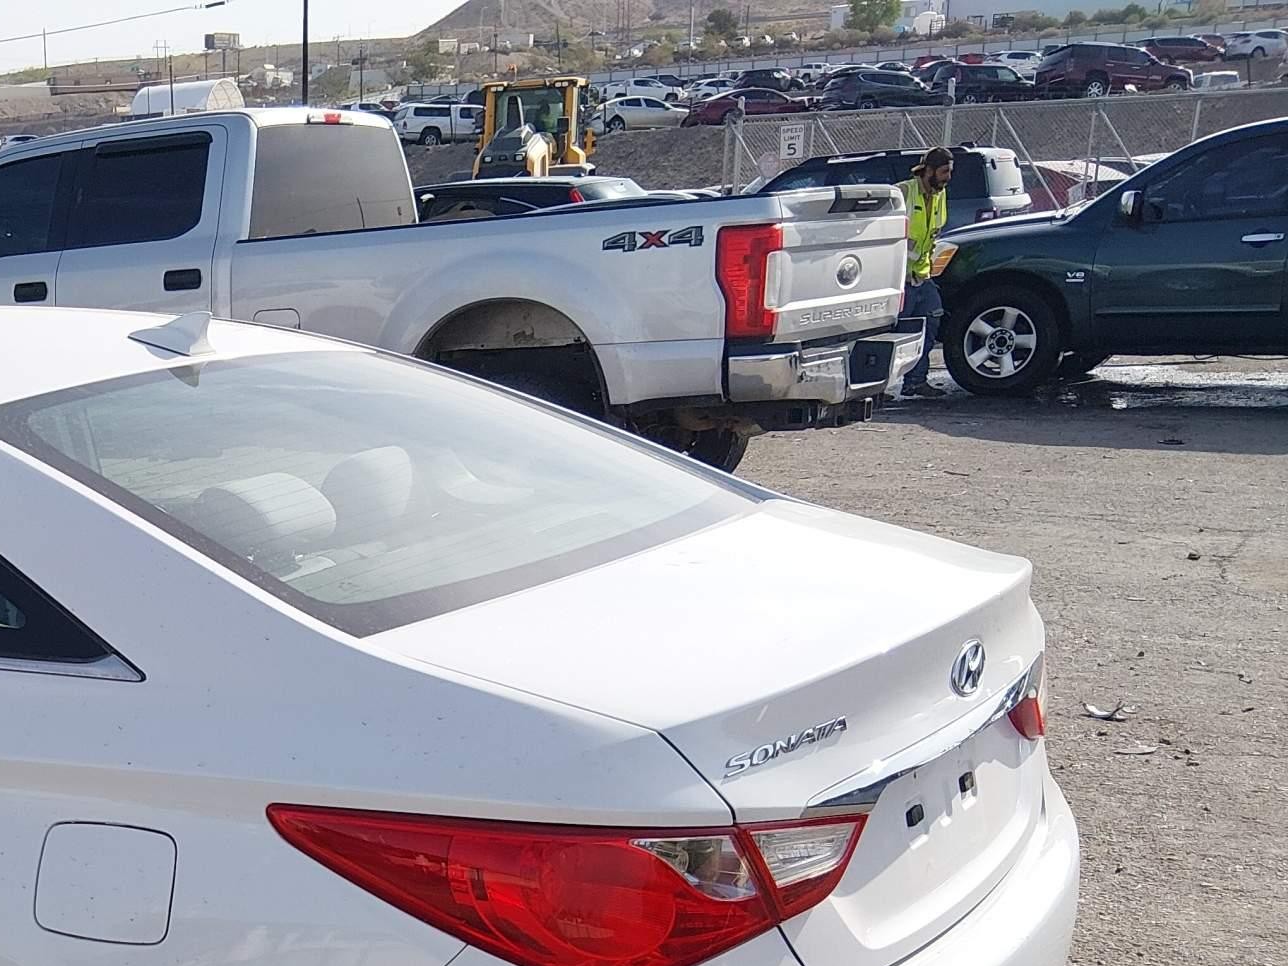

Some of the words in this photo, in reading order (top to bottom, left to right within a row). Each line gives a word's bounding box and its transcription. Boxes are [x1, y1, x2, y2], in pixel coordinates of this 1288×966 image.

[782, 126, 804, 134] SPEED
[783, 134, 801, 142] LIMIT
[787, 143, 797, 156] 5
[723, 715, 847, 779] SONATA
